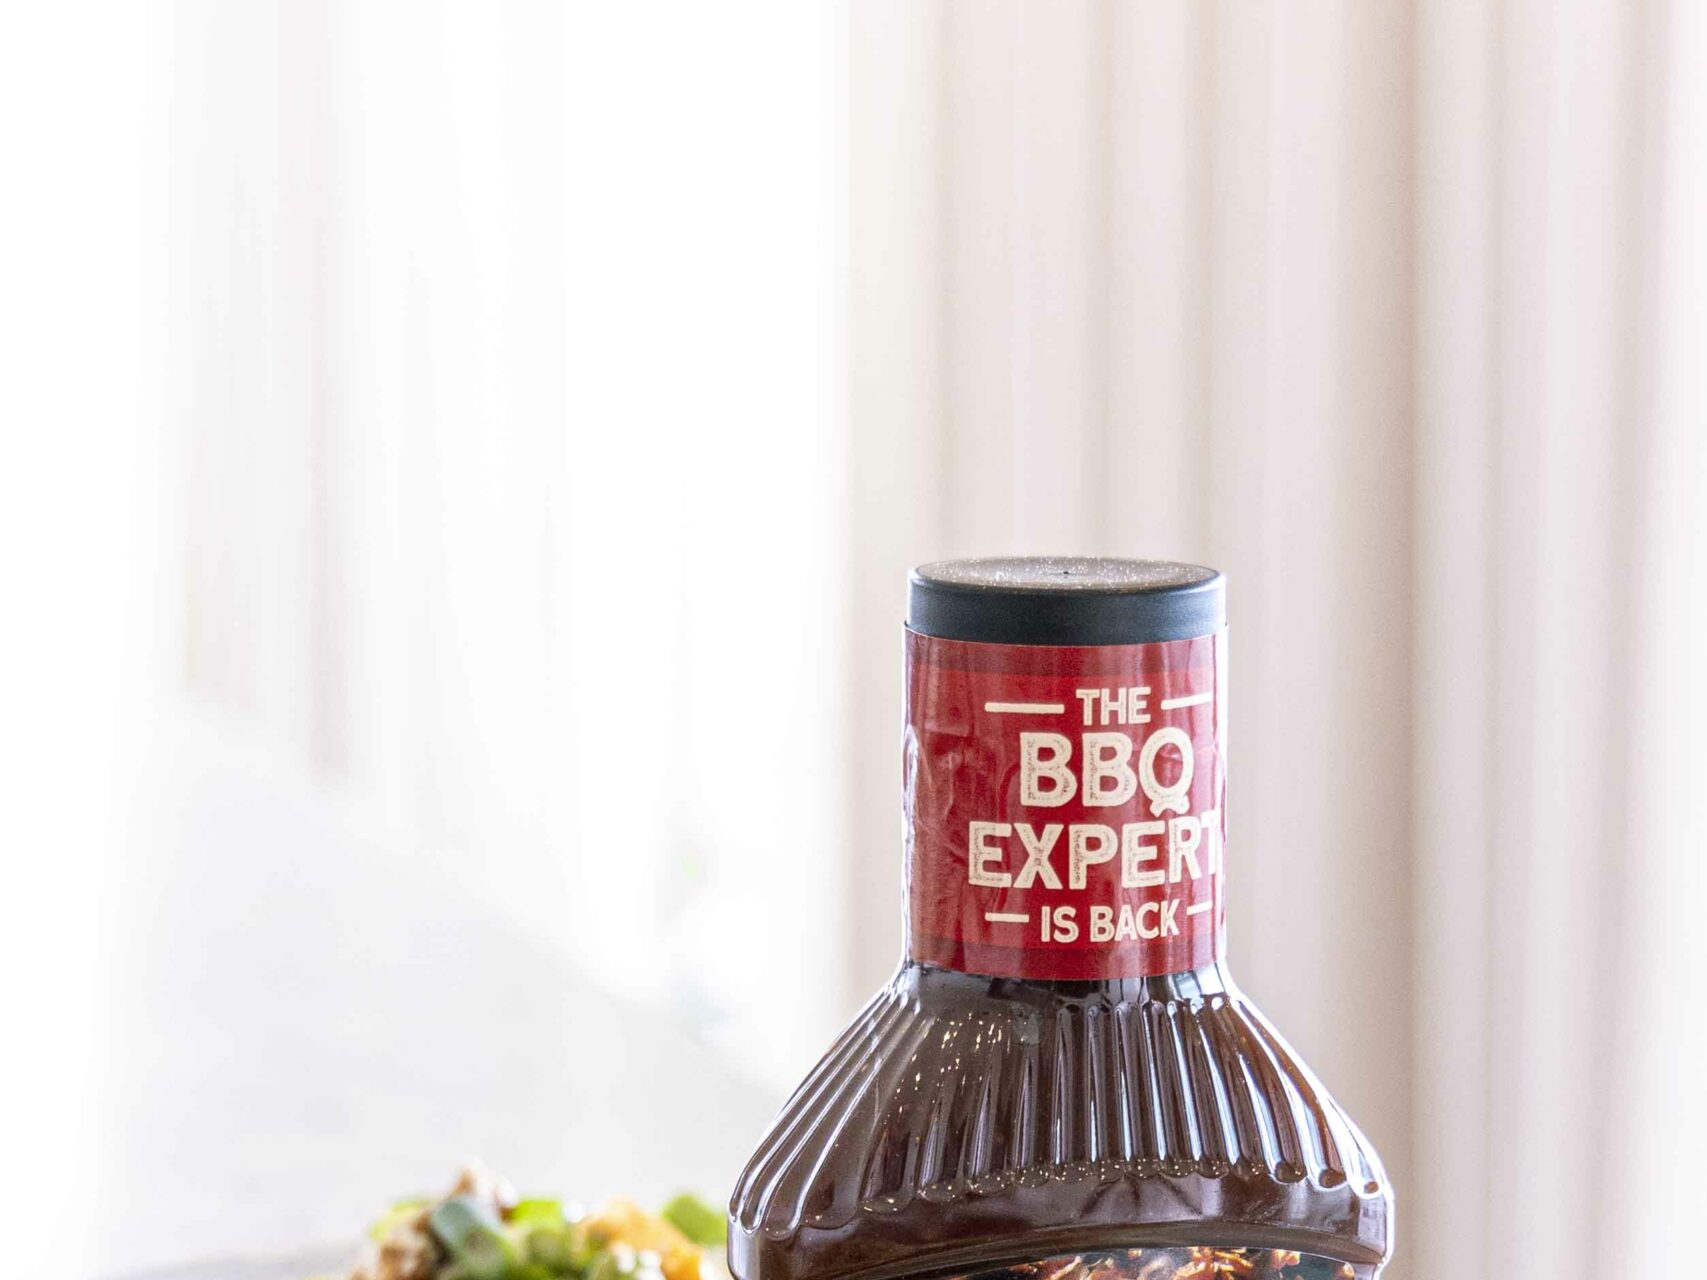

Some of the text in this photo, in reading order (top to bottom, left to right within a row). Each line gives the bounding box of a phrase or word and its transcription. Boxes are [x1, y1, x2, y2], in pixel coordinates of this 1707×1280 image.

[1075, 686, 1151, 726] THE
[1019, 727, 1194, 816] BBQ
[968, 808, 1220, 890] EXPERT
[1040, 900, 1180, 943] IS BACK
